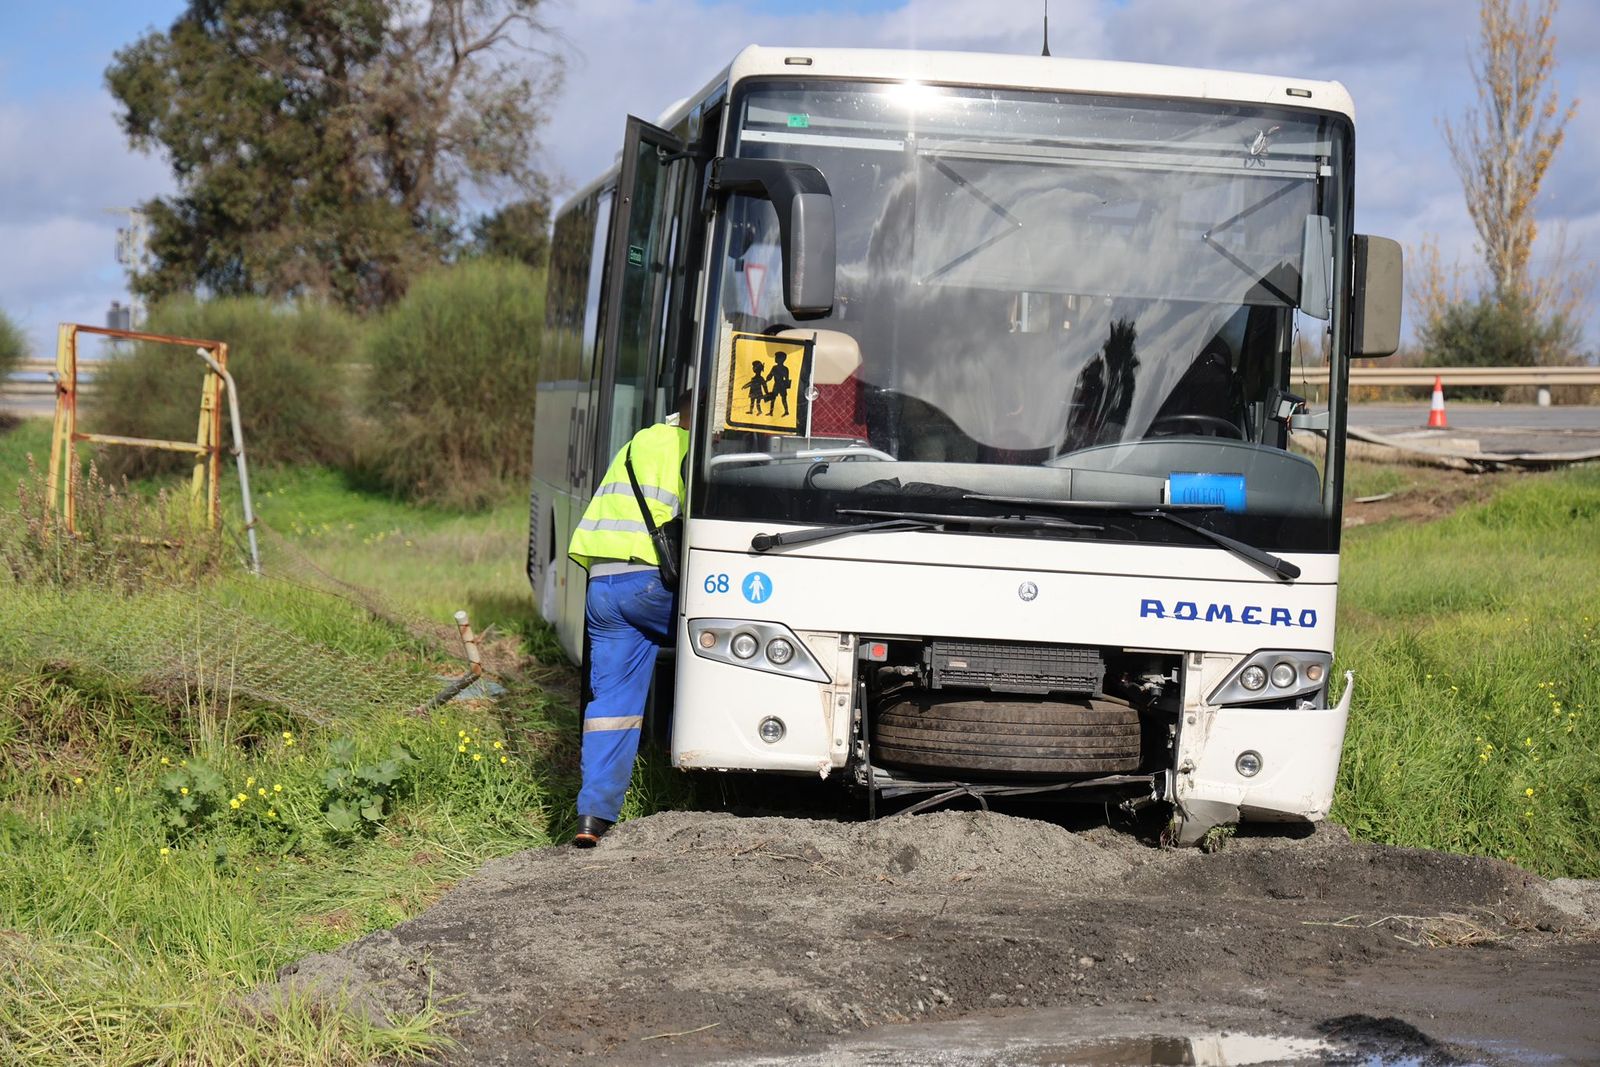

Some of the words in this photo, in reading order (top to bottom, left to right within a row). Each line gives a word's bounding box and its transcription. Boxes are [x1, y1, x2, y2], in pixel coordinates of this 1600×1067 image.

[1183, 487, 1226, 505] COLEGIO
[704, 573, 730, 594] 68
[1140, 599, 1317, 628] ROMERO
